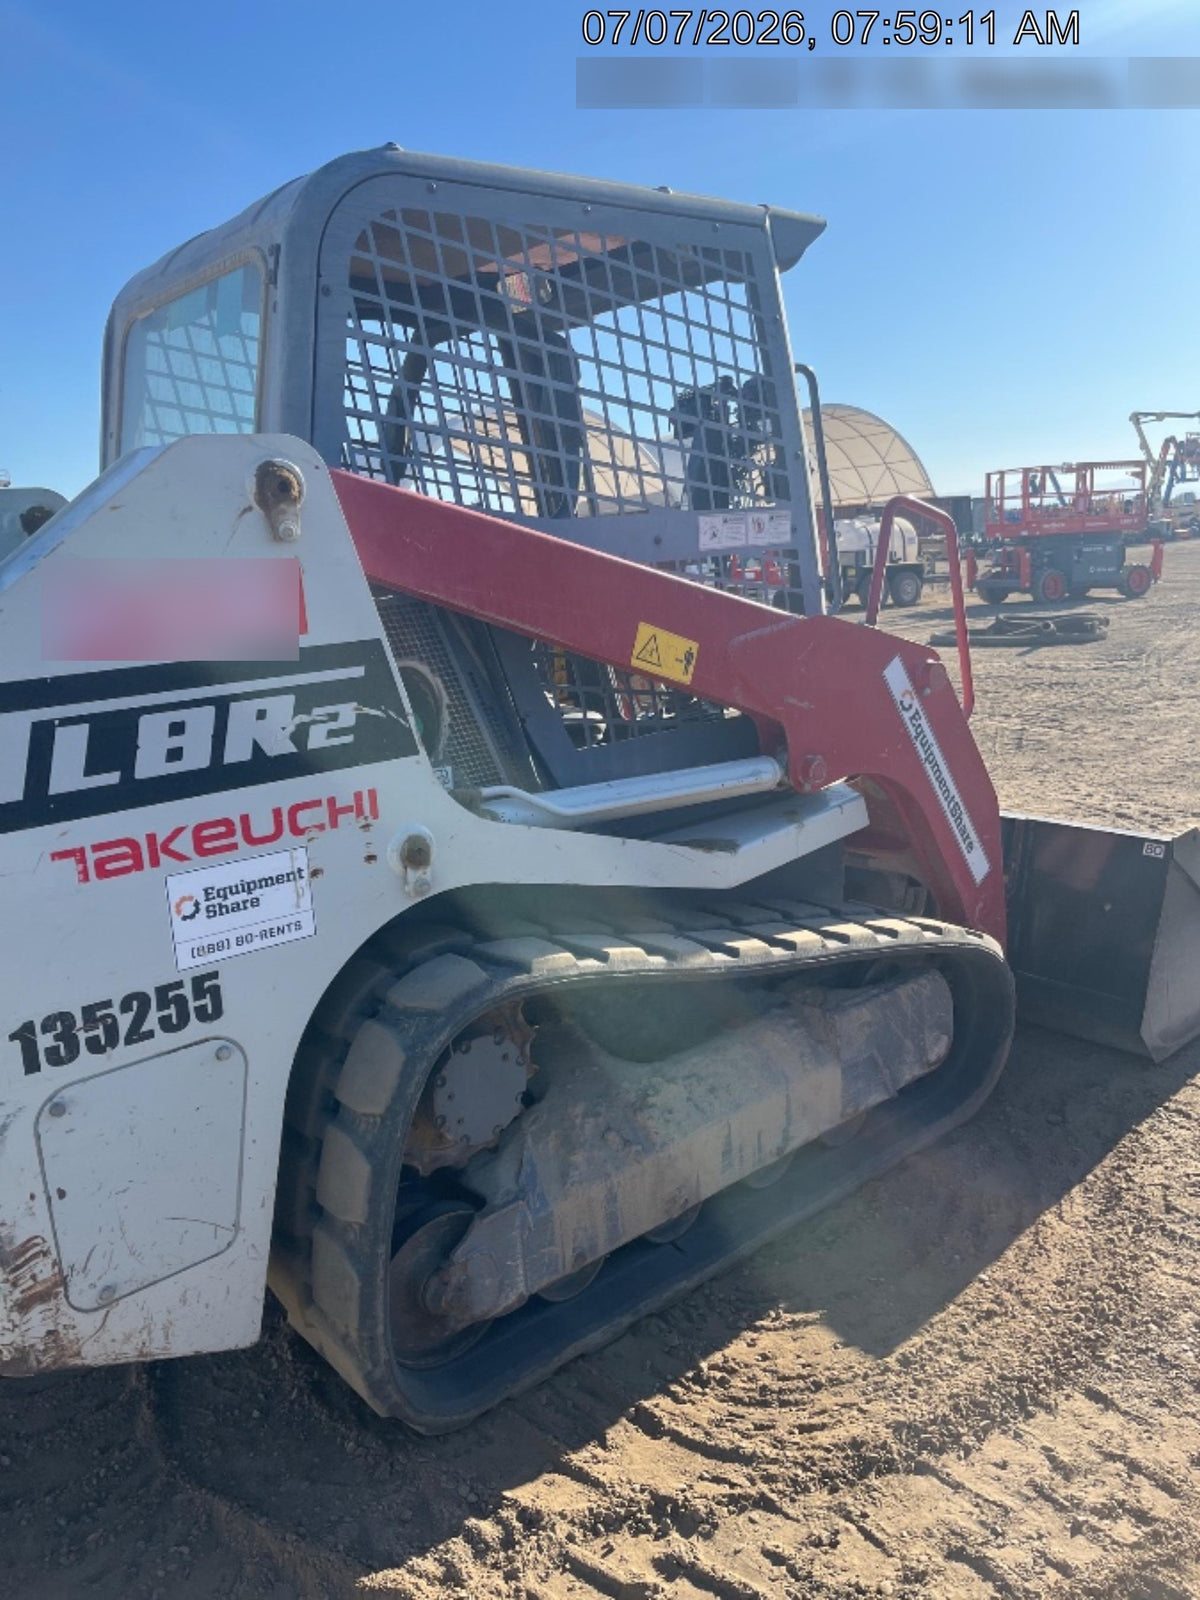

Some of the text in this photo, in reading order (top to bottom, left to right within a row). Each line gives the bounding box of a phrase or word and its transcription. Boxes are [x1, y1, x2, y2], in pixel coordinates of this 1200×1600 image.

[202, 867, 305, 902] Equipment
[204, 896, 260, 919] Share
[8, 970, 225, 1076] 135255
